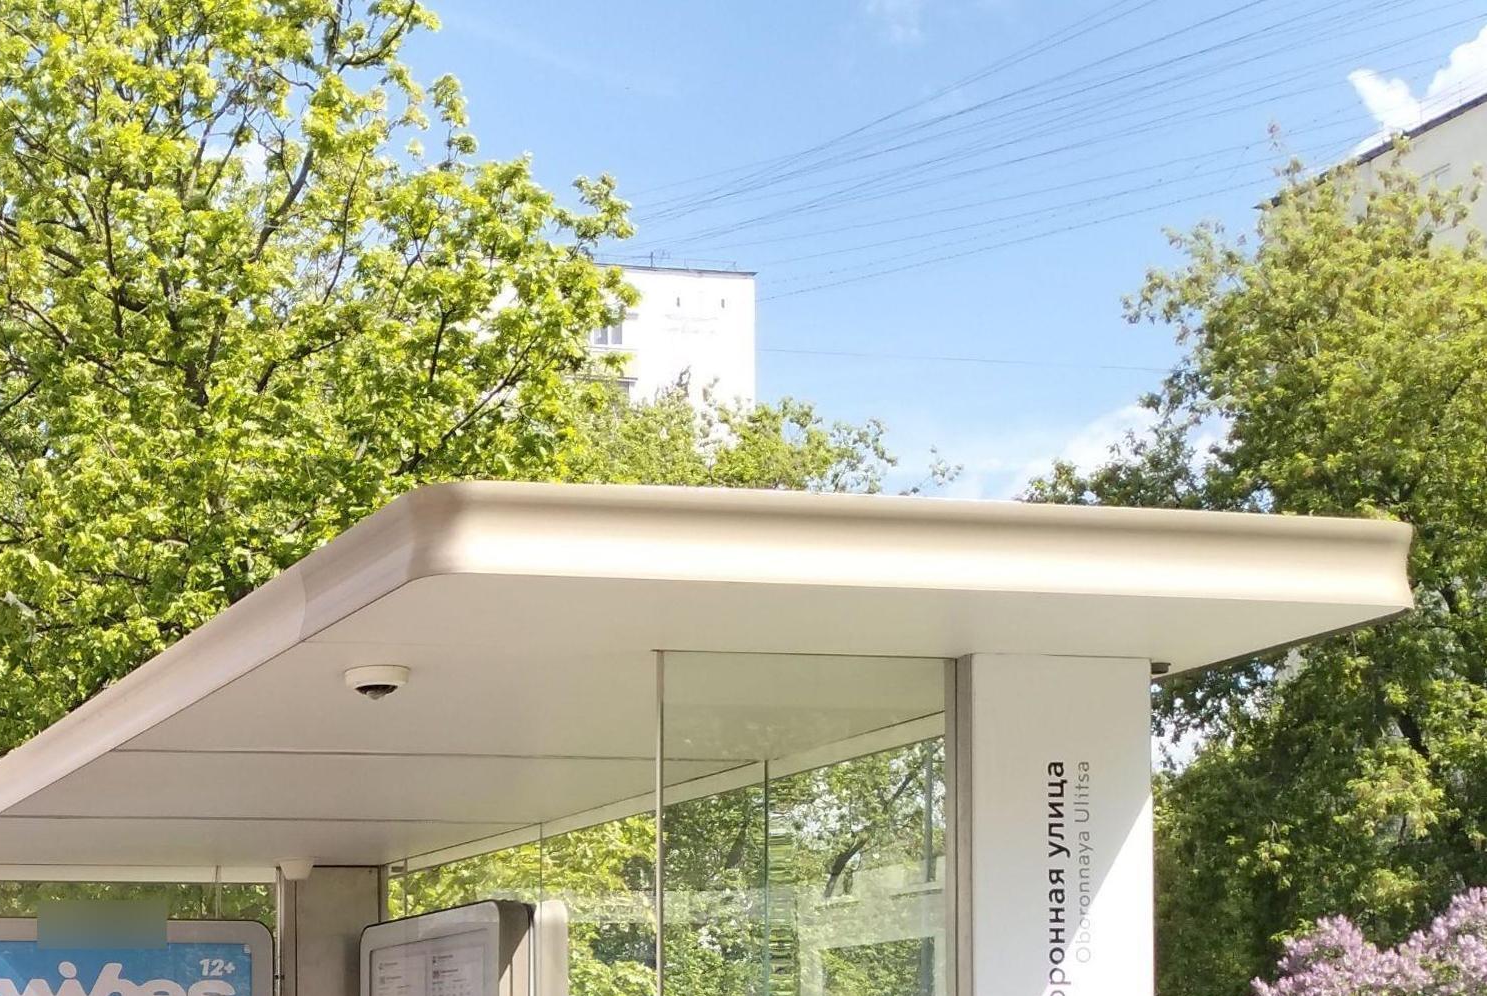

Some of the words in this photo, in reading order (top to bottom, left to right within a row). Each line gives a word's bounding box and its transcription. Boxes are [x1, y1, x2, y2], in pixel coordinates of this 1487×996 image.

[1046, 761, 1071, 858] улица
[1074, 761, 1091, 823] Ulitsa
[1075, 831, 1094, 964] Oboronnaya
[199, 958, 236, 977] 12+
